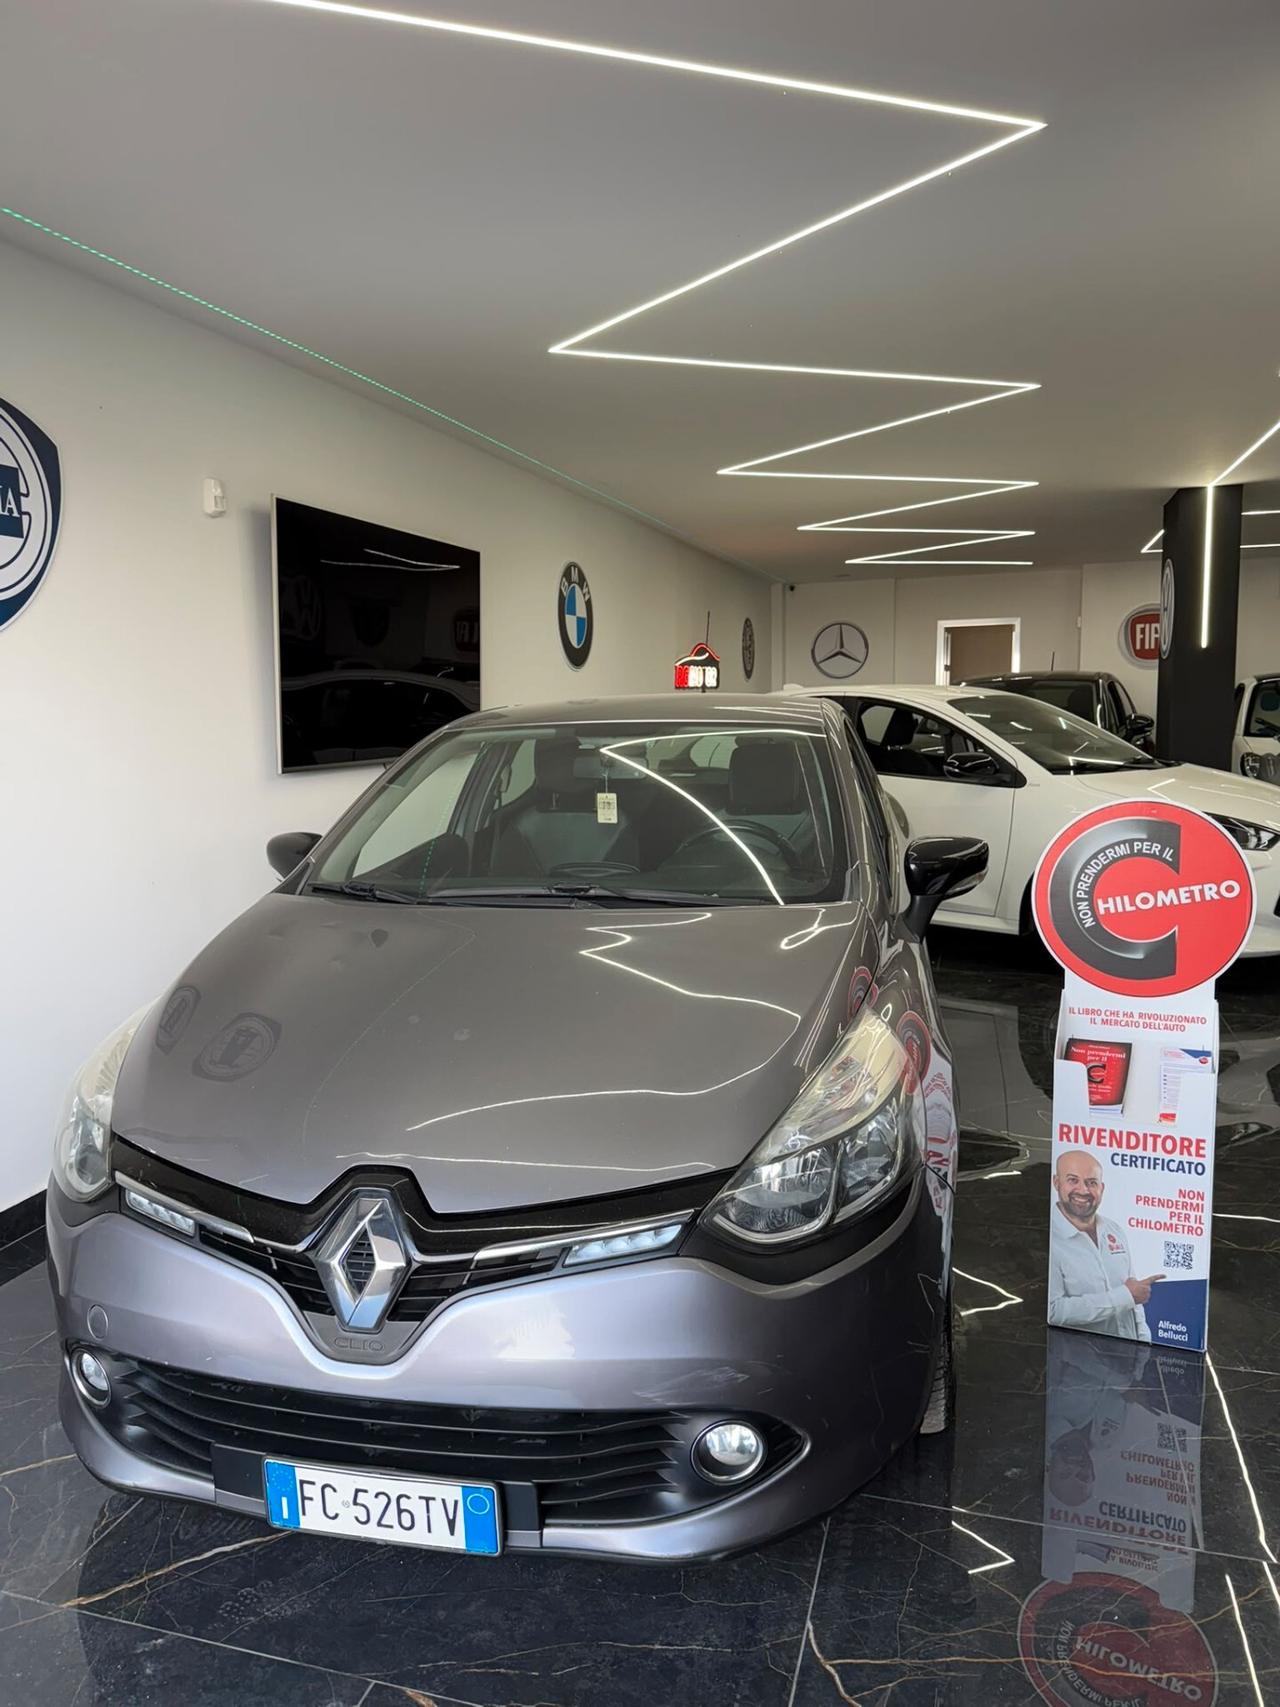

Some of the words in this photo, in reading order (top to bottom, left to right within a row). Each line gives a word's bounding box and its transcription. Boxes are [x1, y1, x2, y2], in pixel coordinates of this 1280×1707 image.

[561, 566, 591, 601] BMW
[1134, 841, 1160, 856] PER
[1162, 847, 1175, 862] IL
[1076, 842, 1131, 899] PRENDERMI
[1077, 902, 1096, 928] NON
[1068, 1007, 1077, 1015] IL
[1078, 1008, 1102, 1017] LIBRO
[1104, 1009, 1121, 1019] CHE
[1122, 1010, 1135, 1019] HA
[1138, 1011, 1207, 1025] RIVOLUZIONATO
[1089, 1017, 1097, 1025] IL
[1101, 1018, 1140, 1029] MERCATO
[1142, 1021, 1186, 1032] DELL'AUTO
[1058, 1123, 1206, 1158] RIVENDITORE
[1110, 1152, 1206, 1176] CERTIFICATO
[1178, 1189, 1205, 1201] NON
[1135, 1195, 1205, 1213] PRENDERMI
[1169, 1211, 1192, 1223] PER
[1194, 1213, 1205, 1225] IL
[1128, 1217, 1204, 1237] CHILOMETRO
[1158, 1320, 1187, 1333] Alfredo
[1158, 1329, 1188, 1342] Bellucci
[335, 1337, 384, 1352] CLIO
